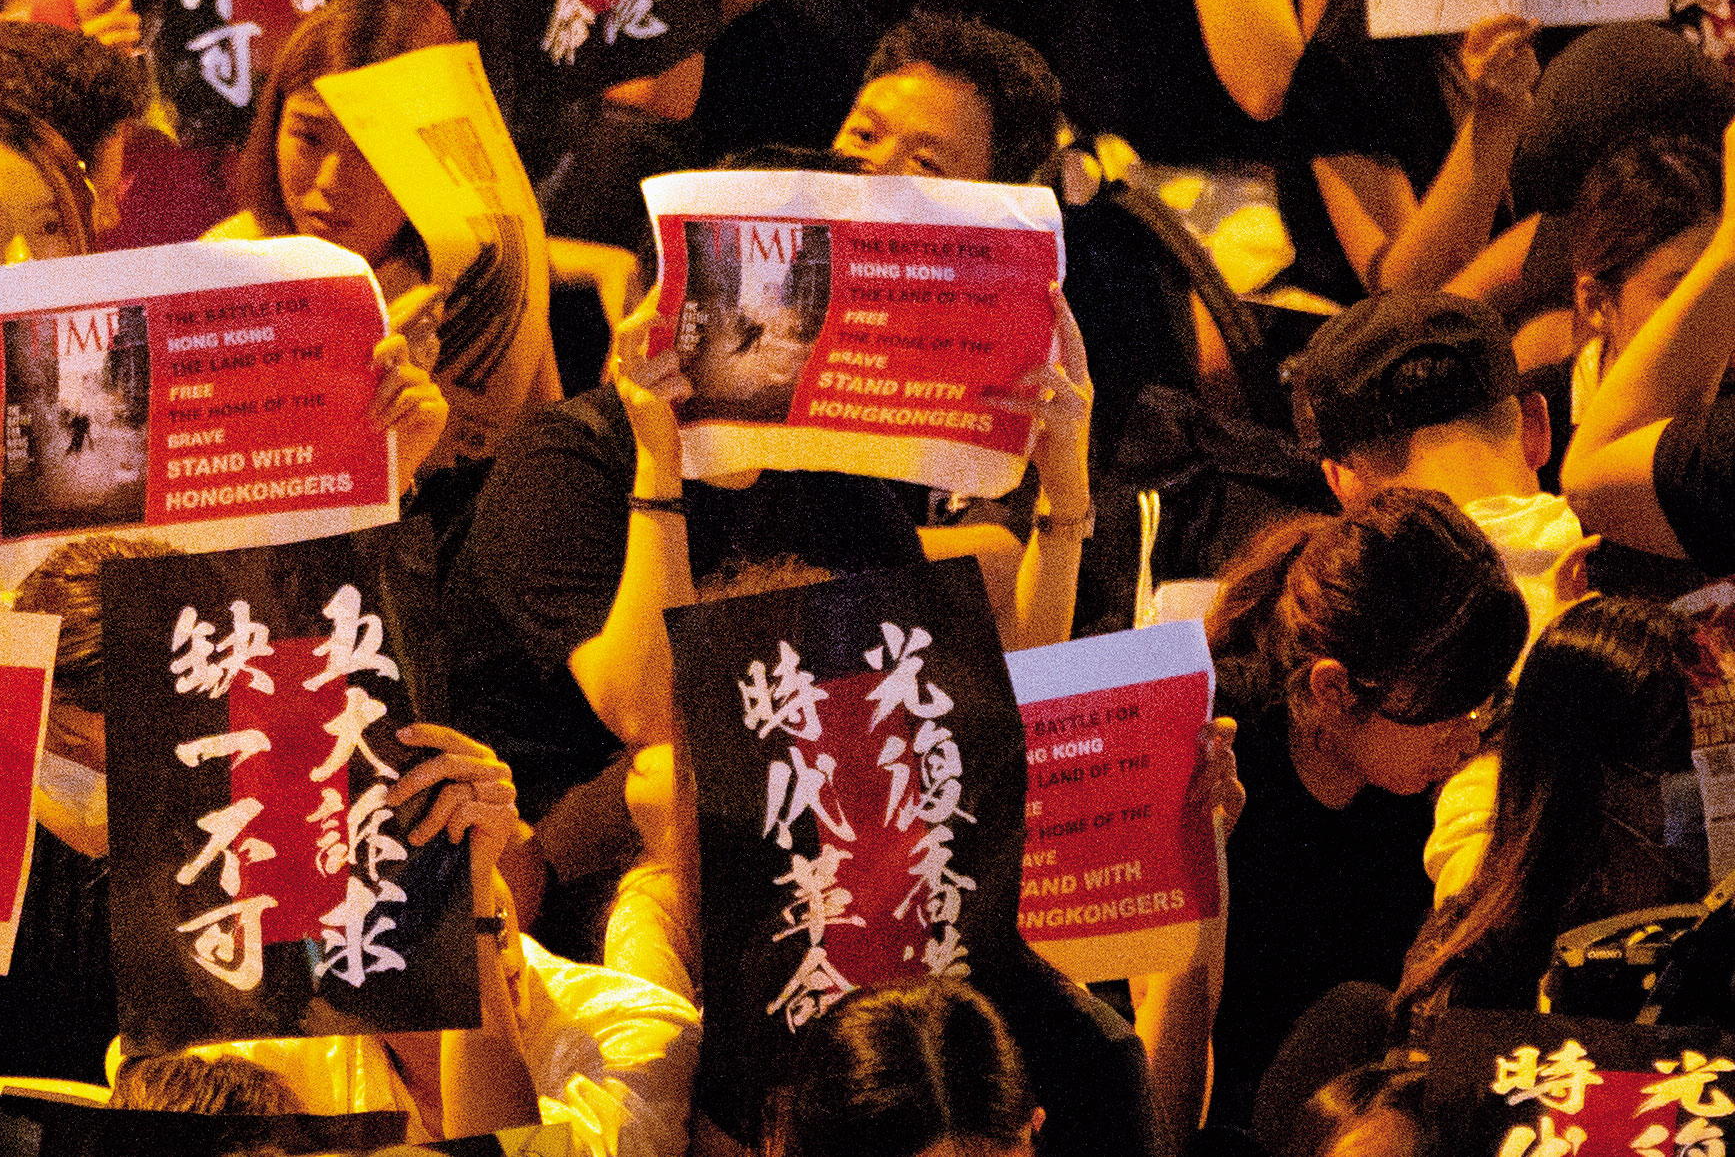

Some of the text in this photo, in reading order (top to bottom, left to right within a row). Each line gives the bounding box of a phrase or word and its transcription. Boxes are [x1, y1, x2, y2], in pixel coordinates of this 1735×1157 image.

[850, 262, 956, 282] HONG KONG
[204, 302, 270, 323] BATTLE
[276, 296, 309, 314] FOR
[844, 310, 889, 326] FREE
[168, 326, 274, 352] HONG KONG
[172, 345, 324, 377] THE LAND OF THE
[827, 350, 889, 370] BRAVE
[170, 383, 214, 401] FREE
[818, 371, 967, 401] STAND WITH
[170, 407, 202, 423] THE
[208, 401, 257, 419] HOME
[293, 393, 326, 409] THE
[809, 400, 994, 434] HONGKONGERS
[168, 428, 225, 448] BRAVE
[168, 445, 313, 479] STAND WITH
[166, 472, 353, 511] HONGKONGERS
[1035, 705, 1140, 735] BATTLE FOR
[1052, 737, 1104, 761] KONG
[303, 584, 408, 988] 五大訴求
[1037, 755, 1150, 789] LAND OF THE
[170, 600, 280, 992] 缺一不可
[738, 640, 868, 1034] 時代革命
[1039, 804, 1153, 841] HOME OF THE
[1083, 860, 1143, 892] WITH
